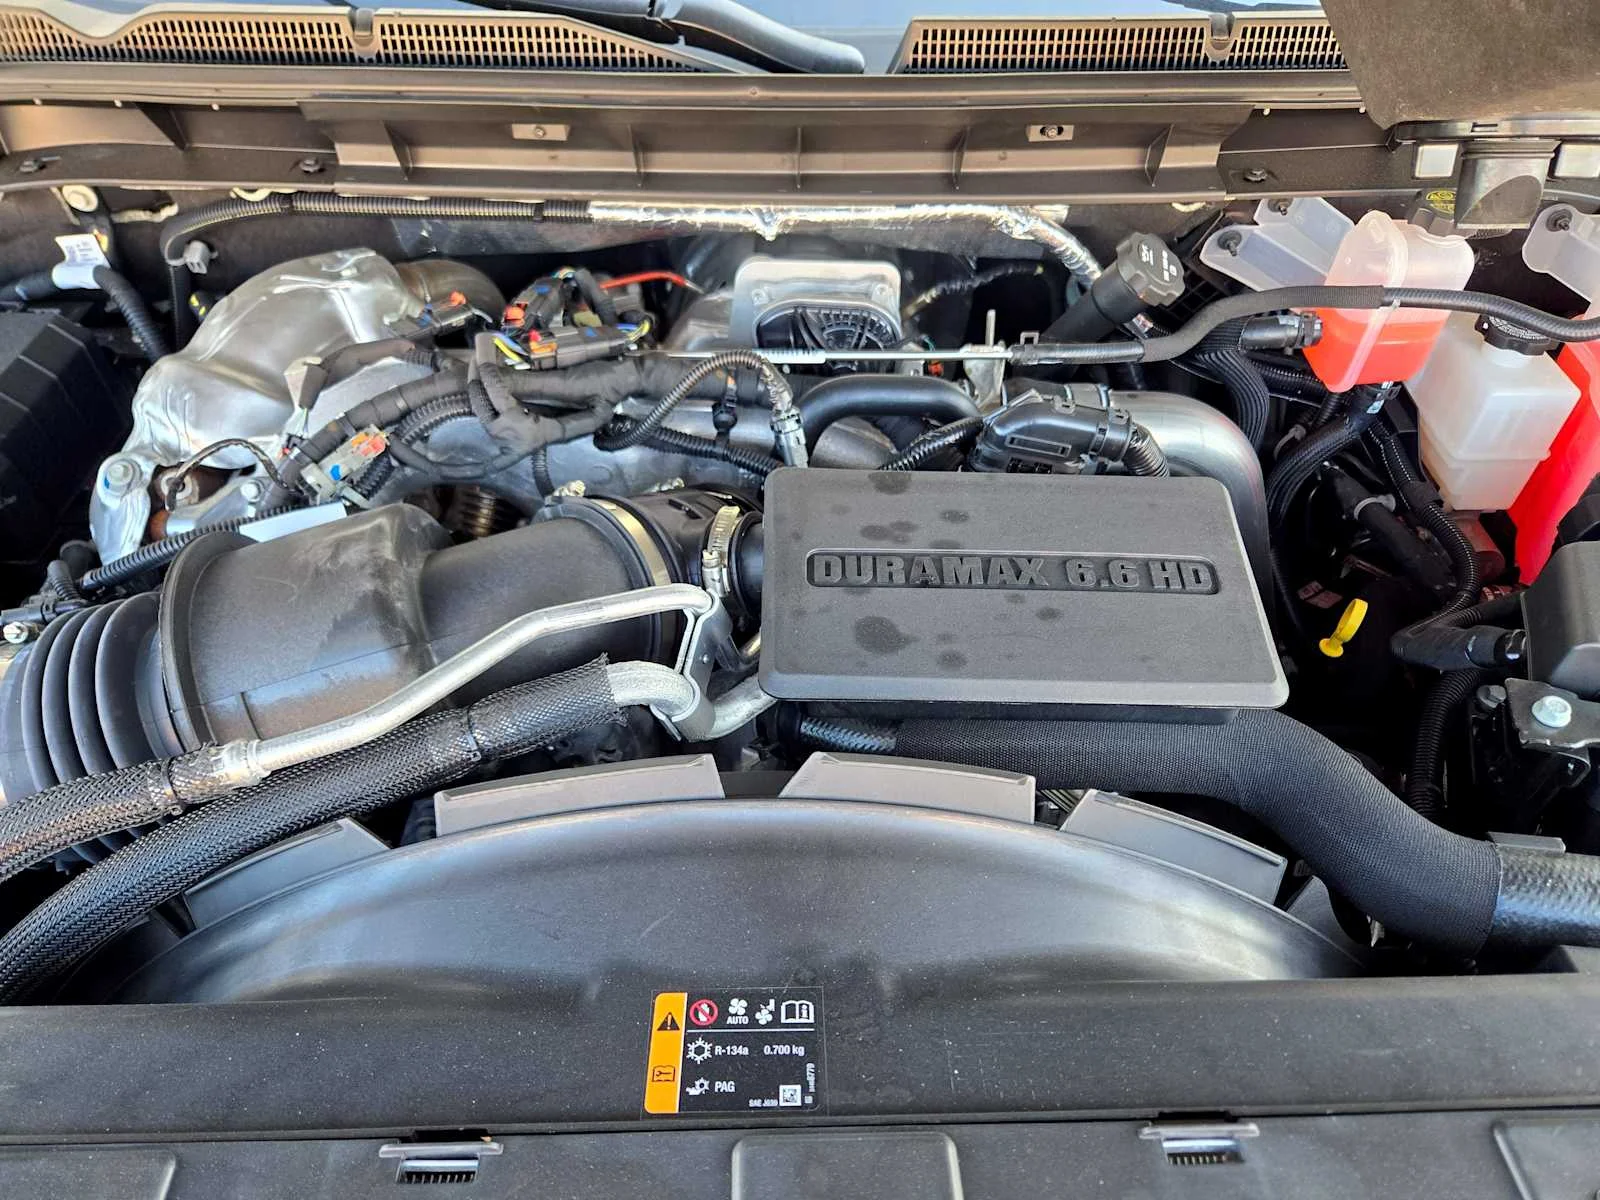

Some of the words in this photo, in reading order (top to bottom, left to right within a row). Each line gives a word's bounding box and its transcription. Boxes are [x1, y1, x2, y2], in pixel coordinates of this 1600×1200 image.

[814, 554, 1049, 586] DURAMAX
[1065, 558, 1140, 588] 6.6
[1150, 560, 1214, 591] HD
[726, 1016, 749, 1025] AUTO
[714, 1045, 749, 1056] R-134a
[763, 1045, 791, 1055] 0.700
[792, 1045, 805, 1056] kg
[714, 1081, 736, 1093] PAG
